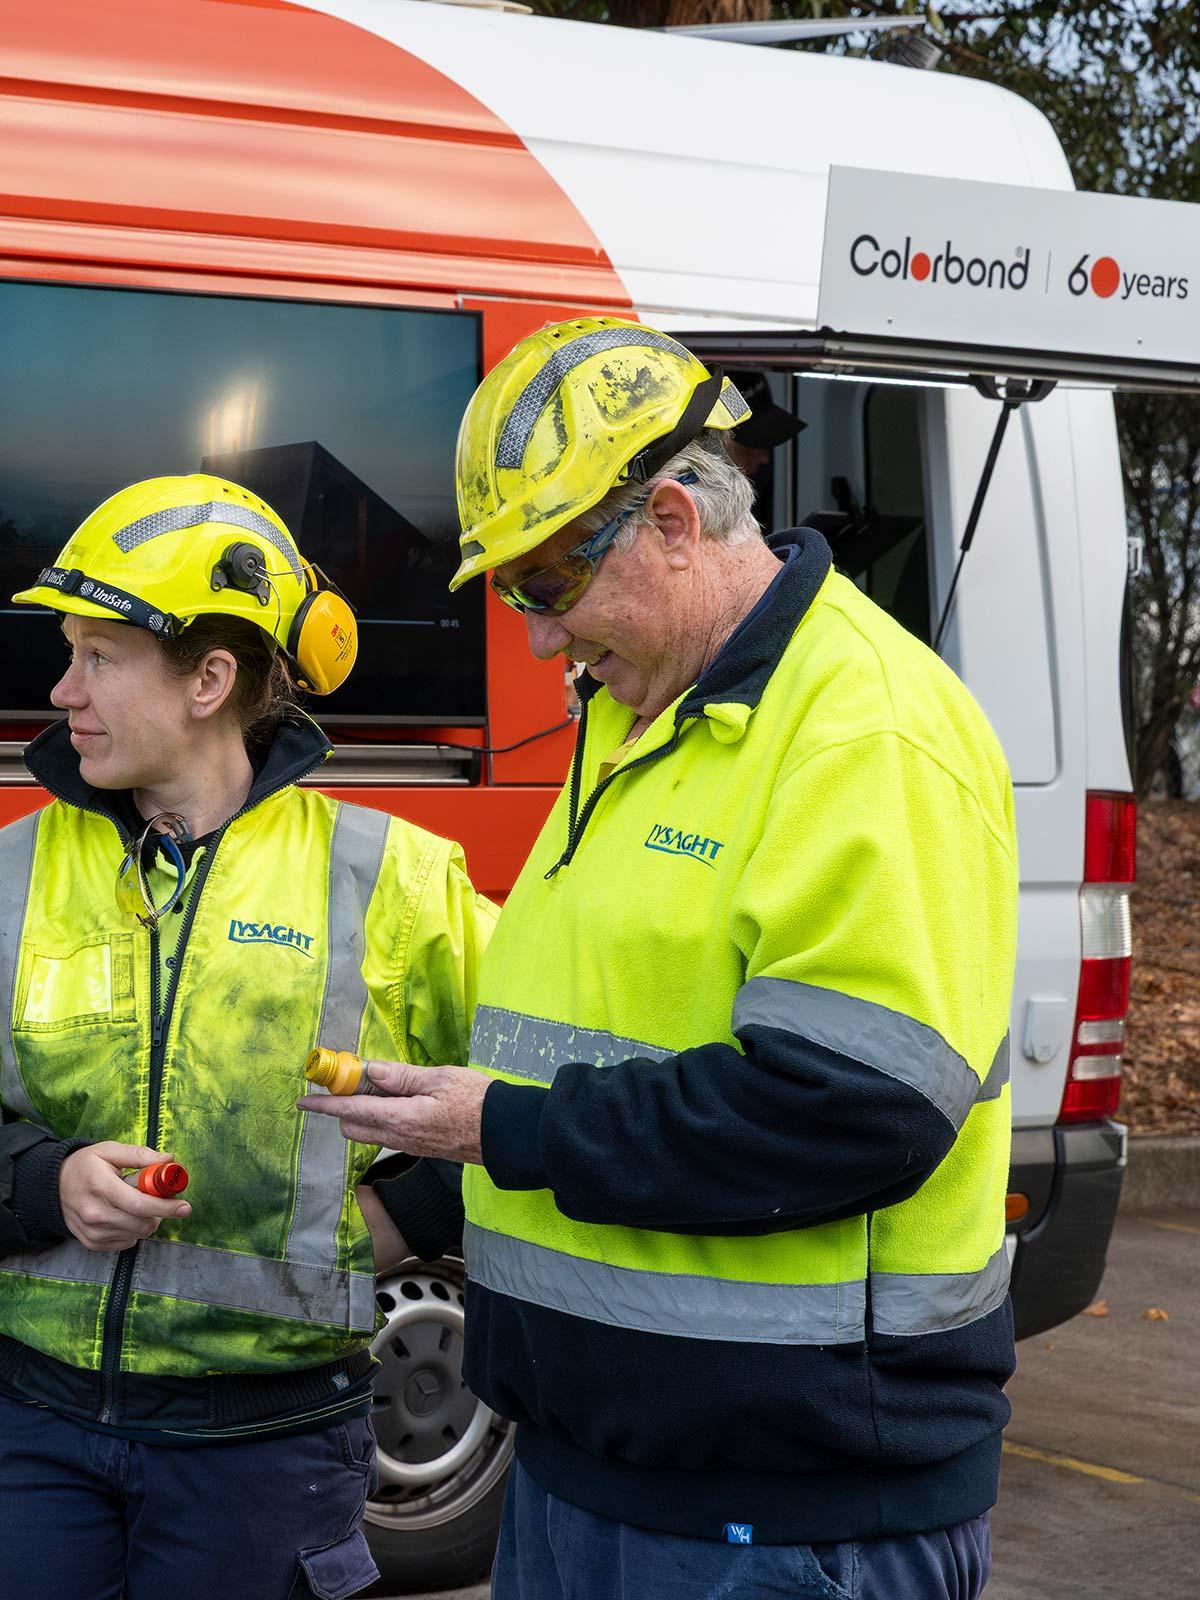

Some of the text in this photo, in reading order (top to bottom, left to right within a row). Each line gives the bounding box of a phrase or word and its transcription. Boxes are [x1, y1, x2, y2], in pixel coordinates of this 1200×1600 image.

[850, 234, 1031, 291] Colorbond
[92, 586, 132, 612] UniSafe
[440, 618, 460, 629] 00:45
[644, 823, 725, 866] LYSAGHT
[228, 919, 315, 952] LYSAGHT
